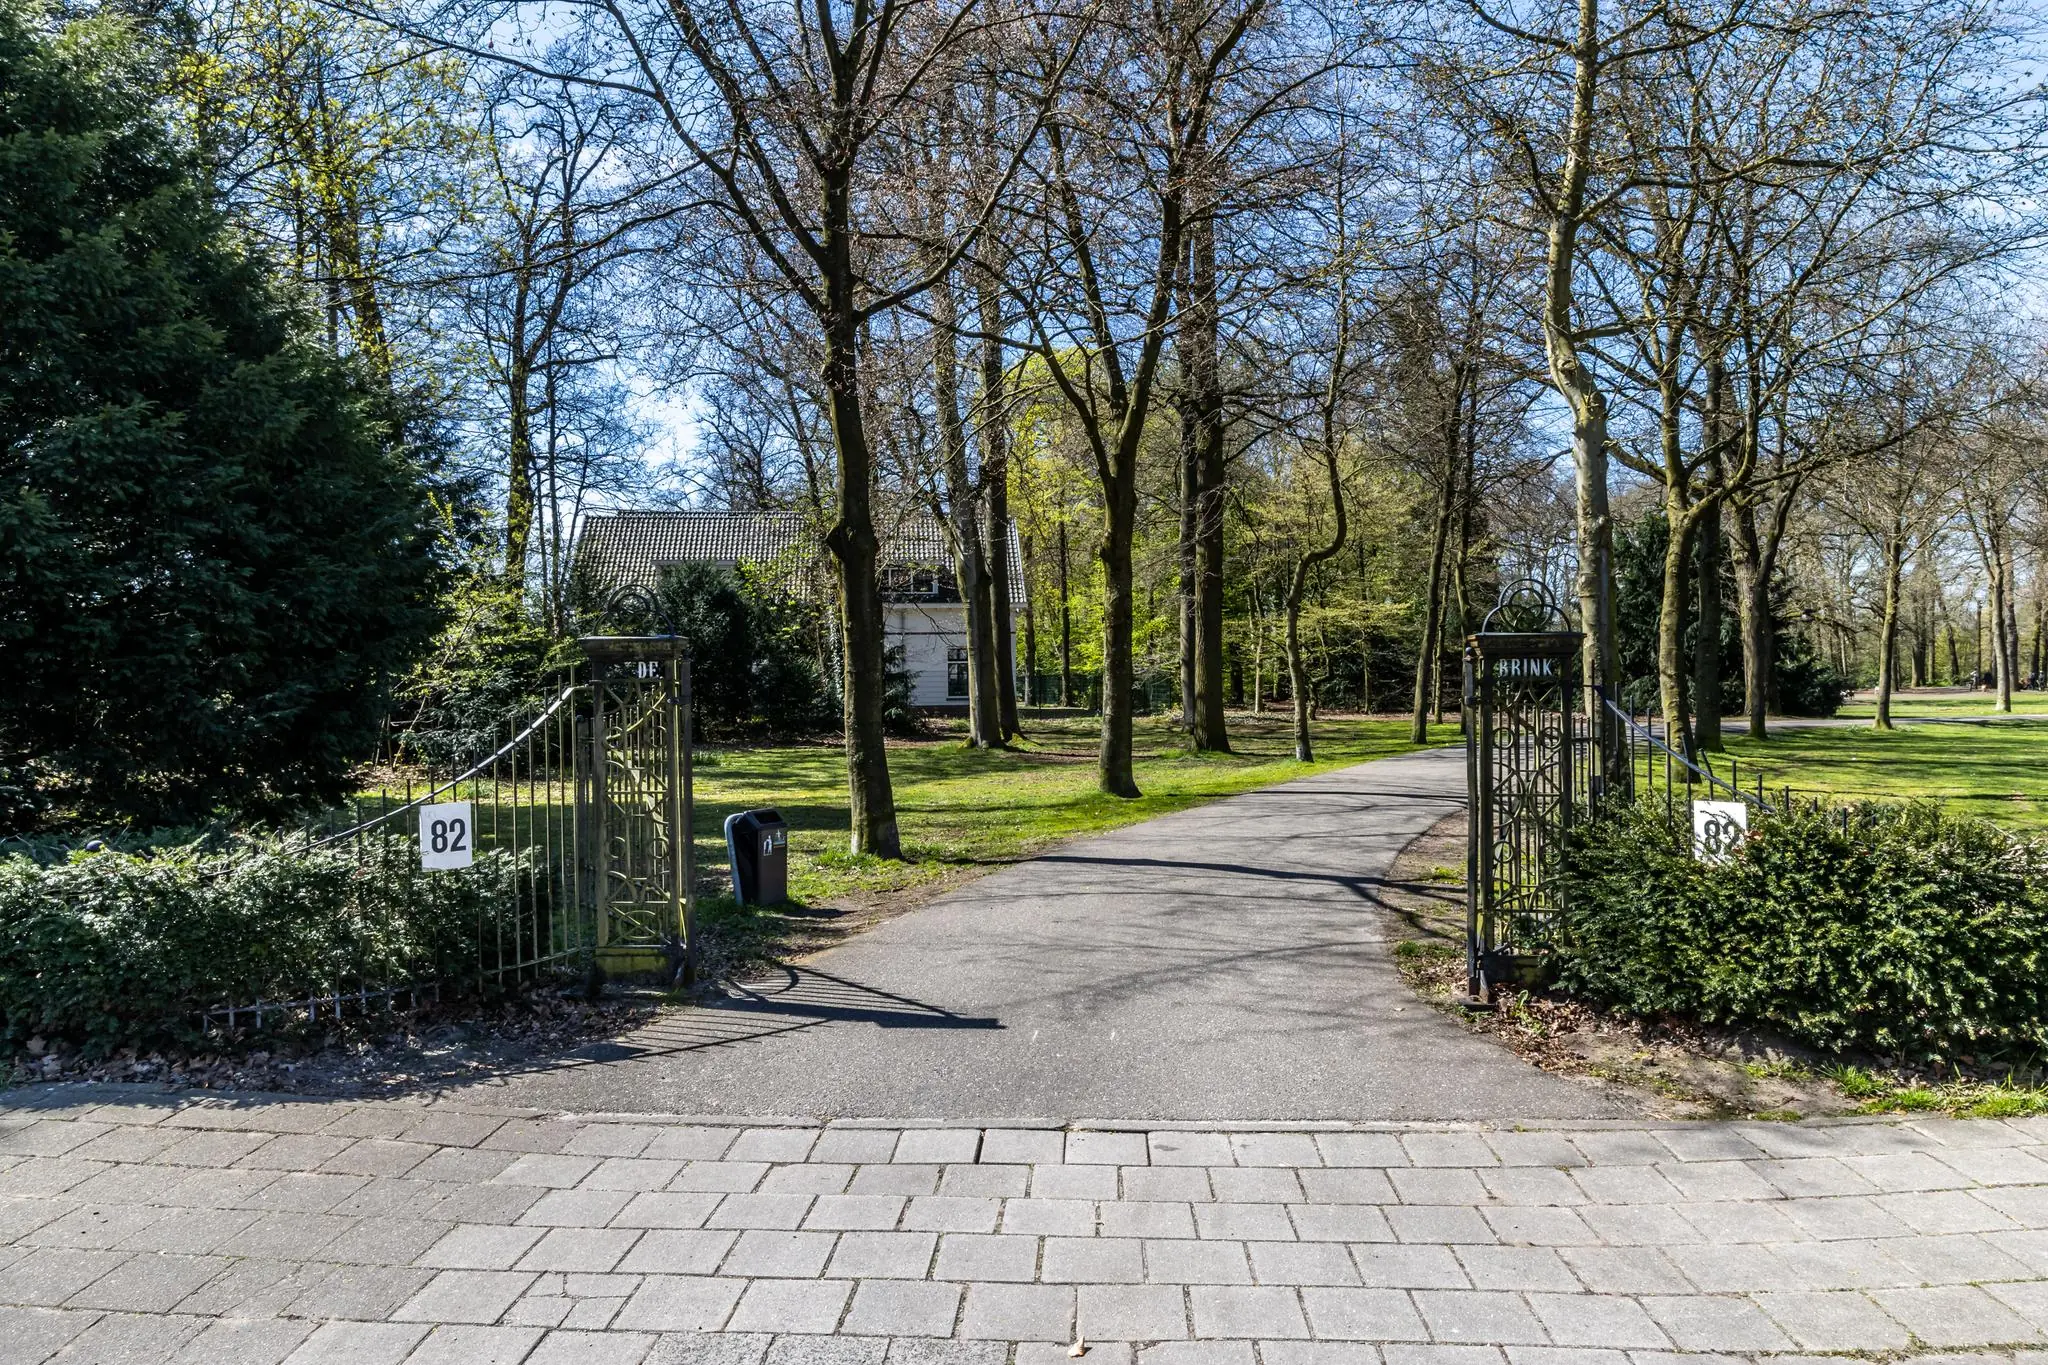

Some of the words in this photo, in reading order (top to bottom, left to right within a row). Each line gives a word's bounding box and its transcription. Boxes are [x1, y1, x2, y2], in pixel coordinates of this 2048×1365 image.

[1499, 658, 1552, 677] BRINK
[431, 818, 467, 853] 82
[1704, 820, 1740, 855] 82
